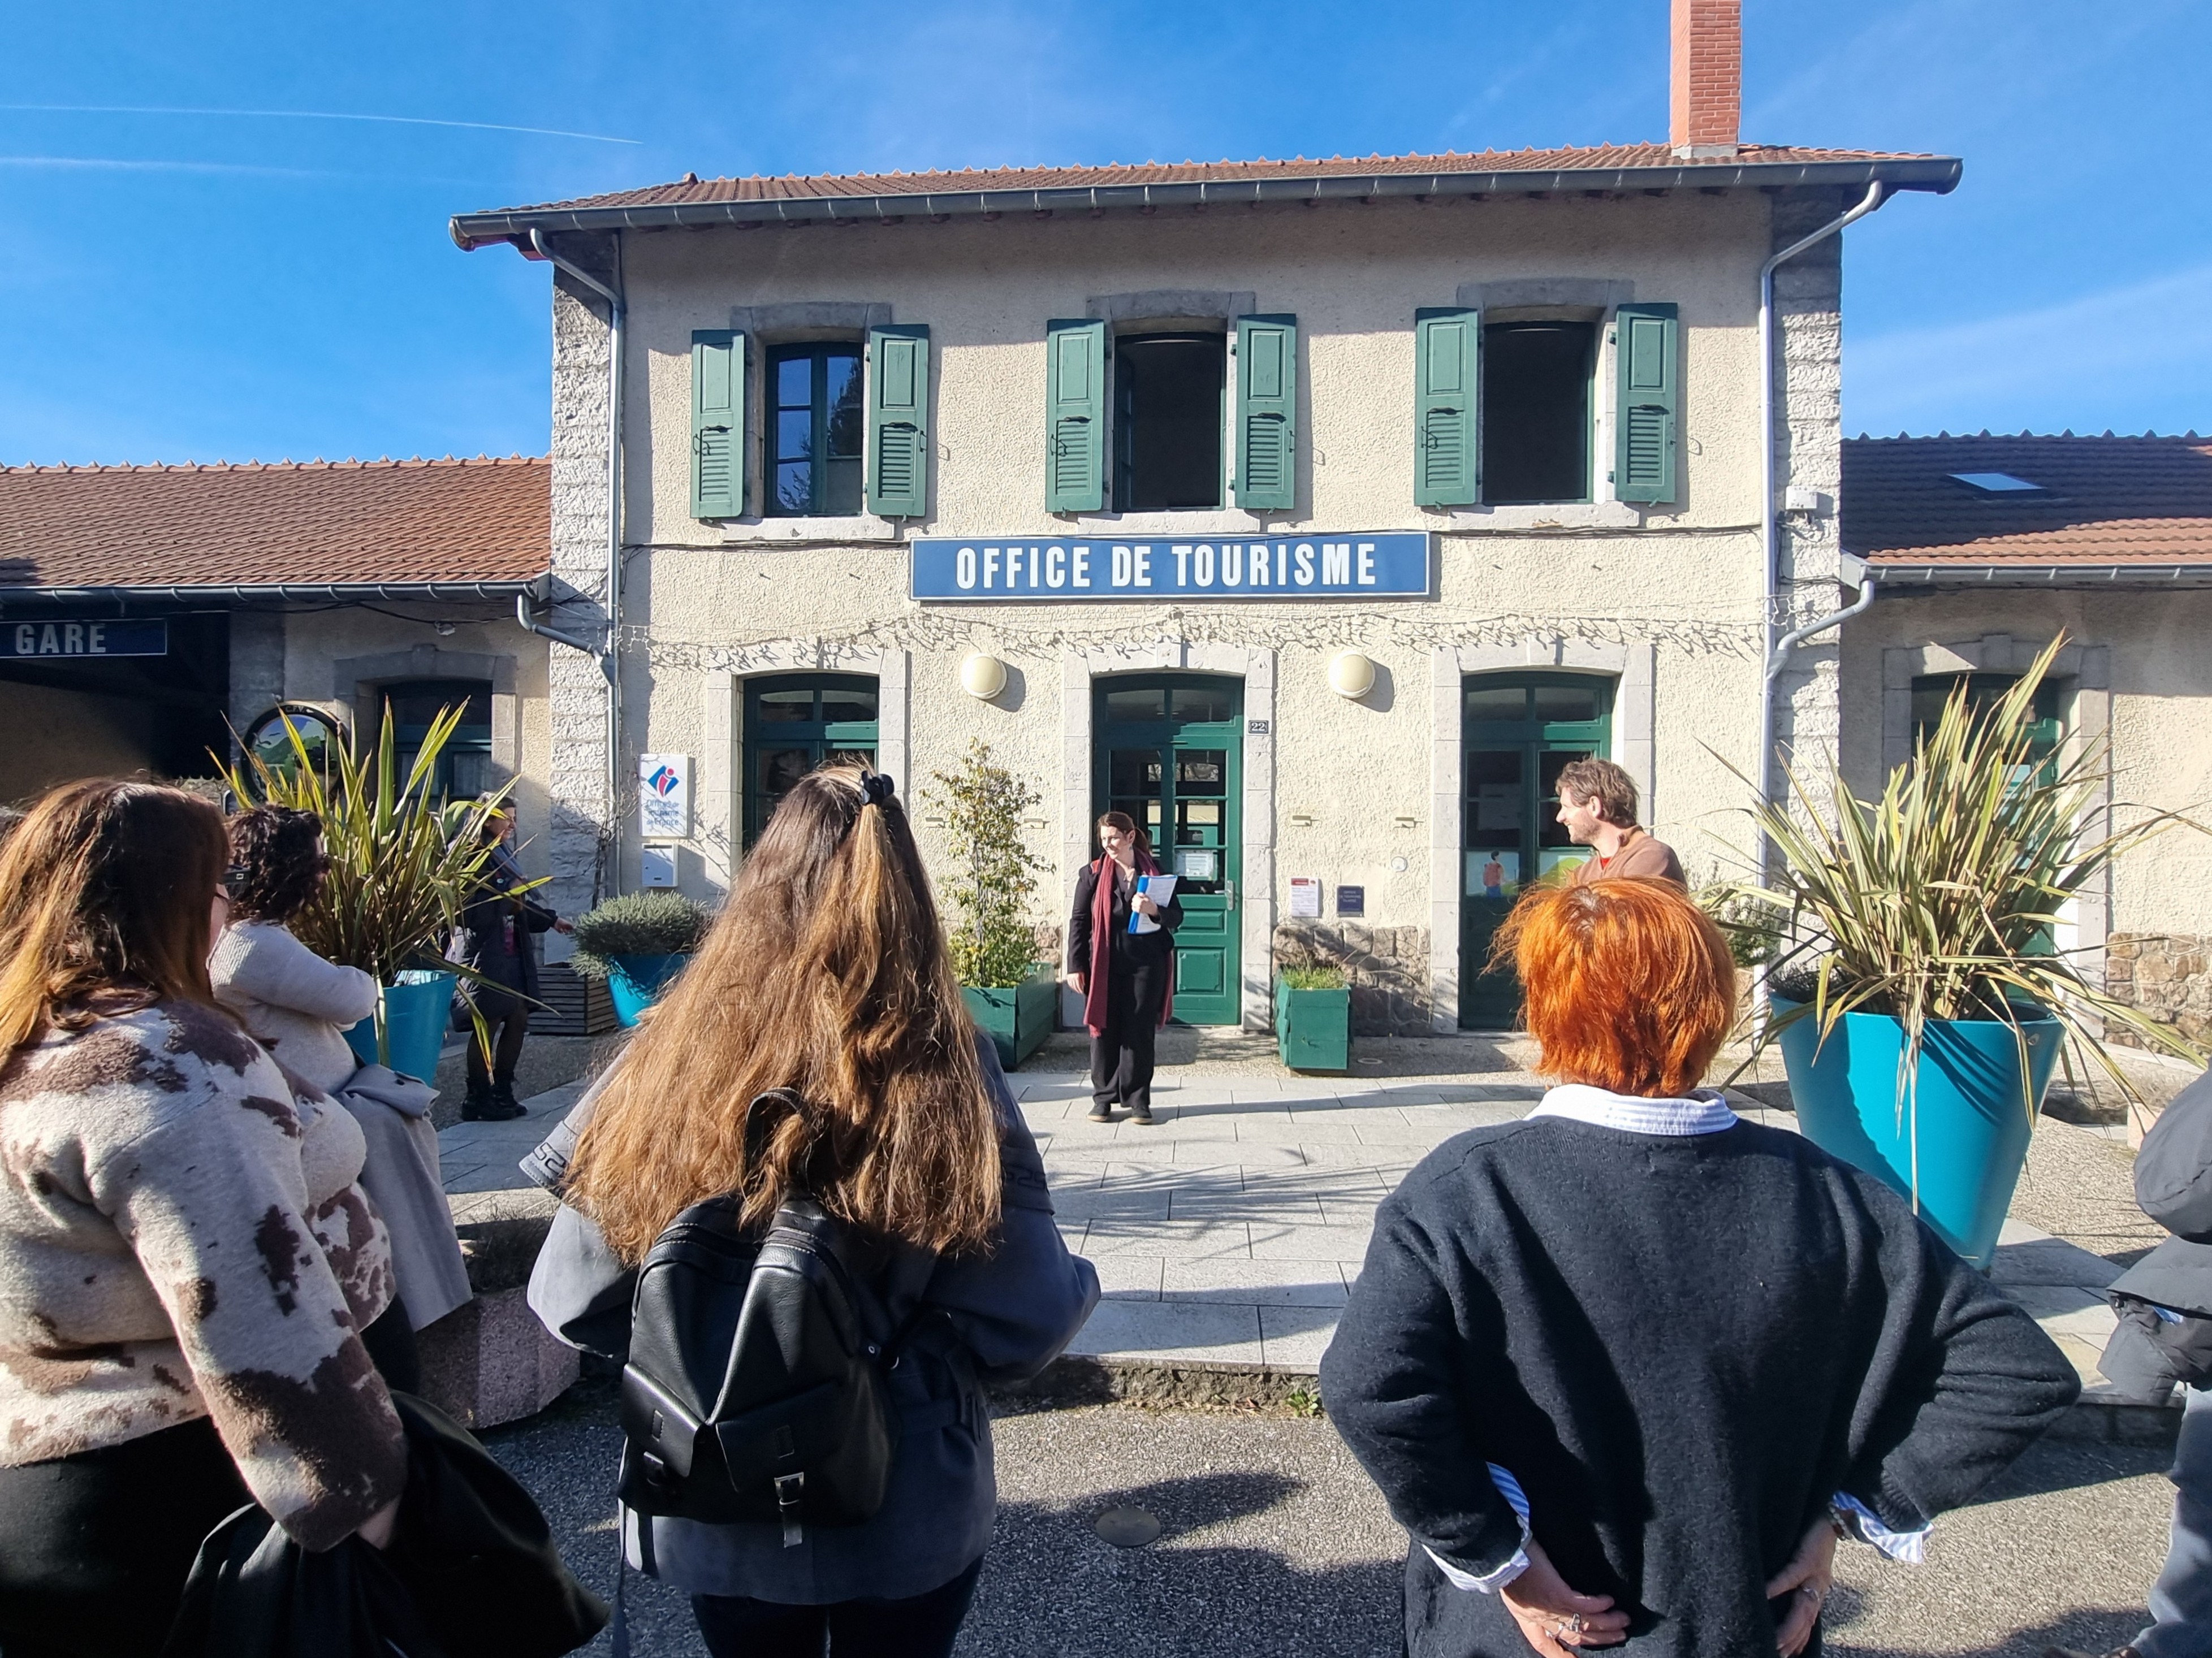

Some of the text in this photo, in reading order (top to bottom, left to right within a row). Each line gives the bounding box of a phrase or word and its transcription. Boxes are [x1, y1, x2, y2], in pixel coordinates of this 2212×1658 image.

[956, 543, 1376, 589] OFFICE DE TOURISME
[15, 624, 106, 655] GARE
[1251, 722, 1265, 731] 22
